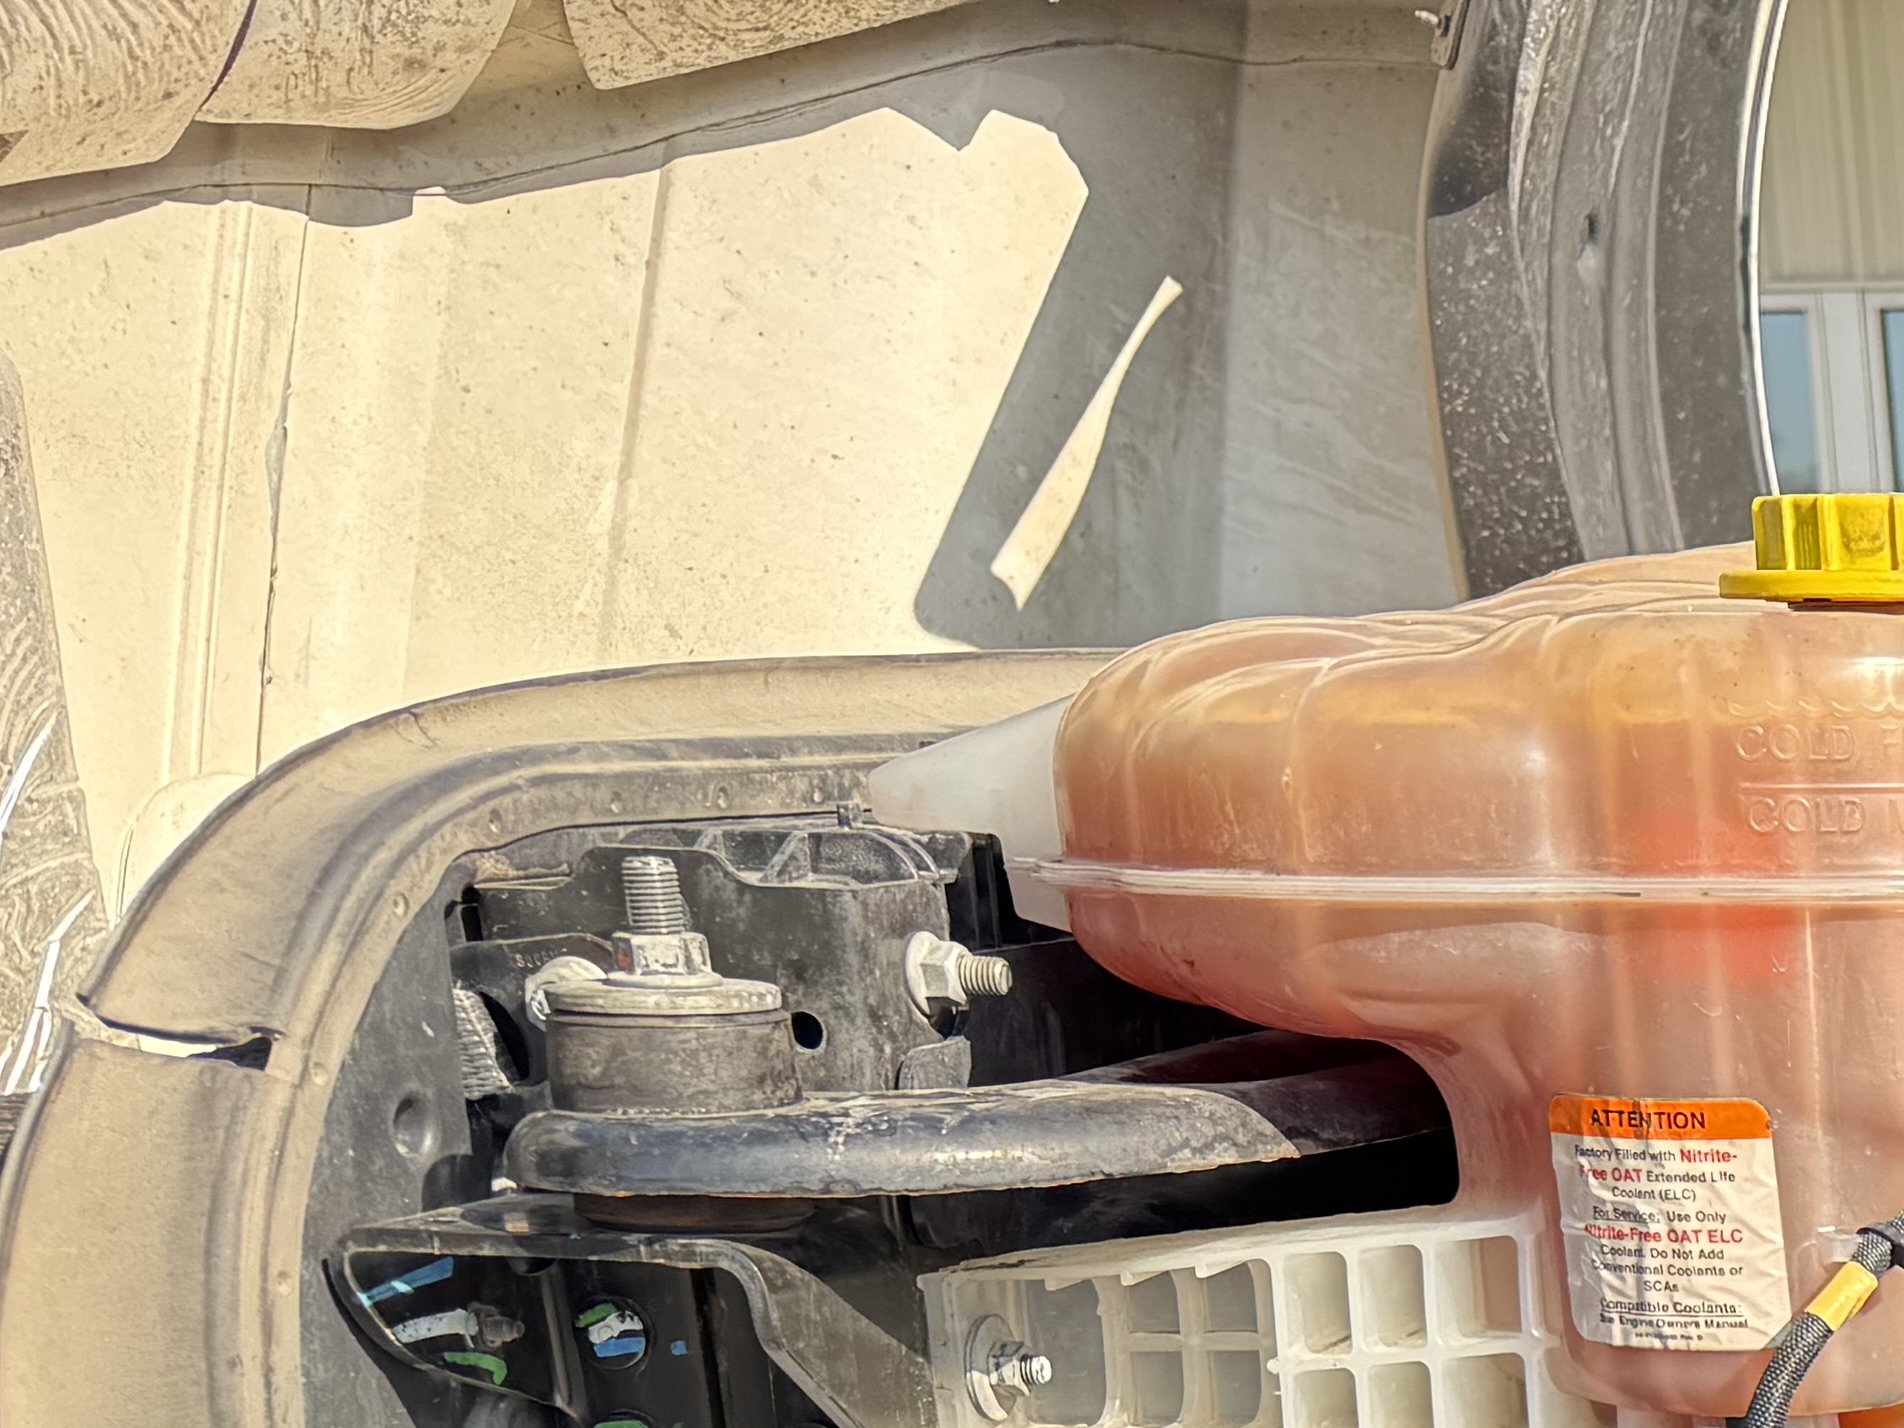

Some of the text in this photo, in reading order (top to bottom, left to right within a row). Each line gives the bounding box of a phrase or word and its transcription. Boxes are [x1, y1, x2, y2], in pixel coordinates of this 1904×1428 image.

[1736, 724, 1855, 761] COLD
[1749, 797, 1865, 833] COLD
[1591, 1109, 1706, 1130] ATTENTION
[1574, 1144, 1738, 1163] Factory Filled with Nitrite-
[1580, 1167, 1736, 1183] Free OAT Extended Life
[1612, 1187, 1697, 1203] Coolant (ELC)
[1593, 1205, 1610, 1220] For
[1666, 1211, 1691, 1223] Use
[1695, 1211, 1727, 1224] Only
[1667, 1228, 1702, 1244] OAT
[1708, 1229, 1743, 1244] ELC
[1650, 1247, 1669, 1259] Do
[1672, 1248, 1694, 1259] Not
[1698, 1248, 1725, 1260] Add
[1667, 1263, 1726, 1277] Coolants
[1729, 1266, 1743, 1276] or
[1643, 1280, 1680, 1293] SCAs
